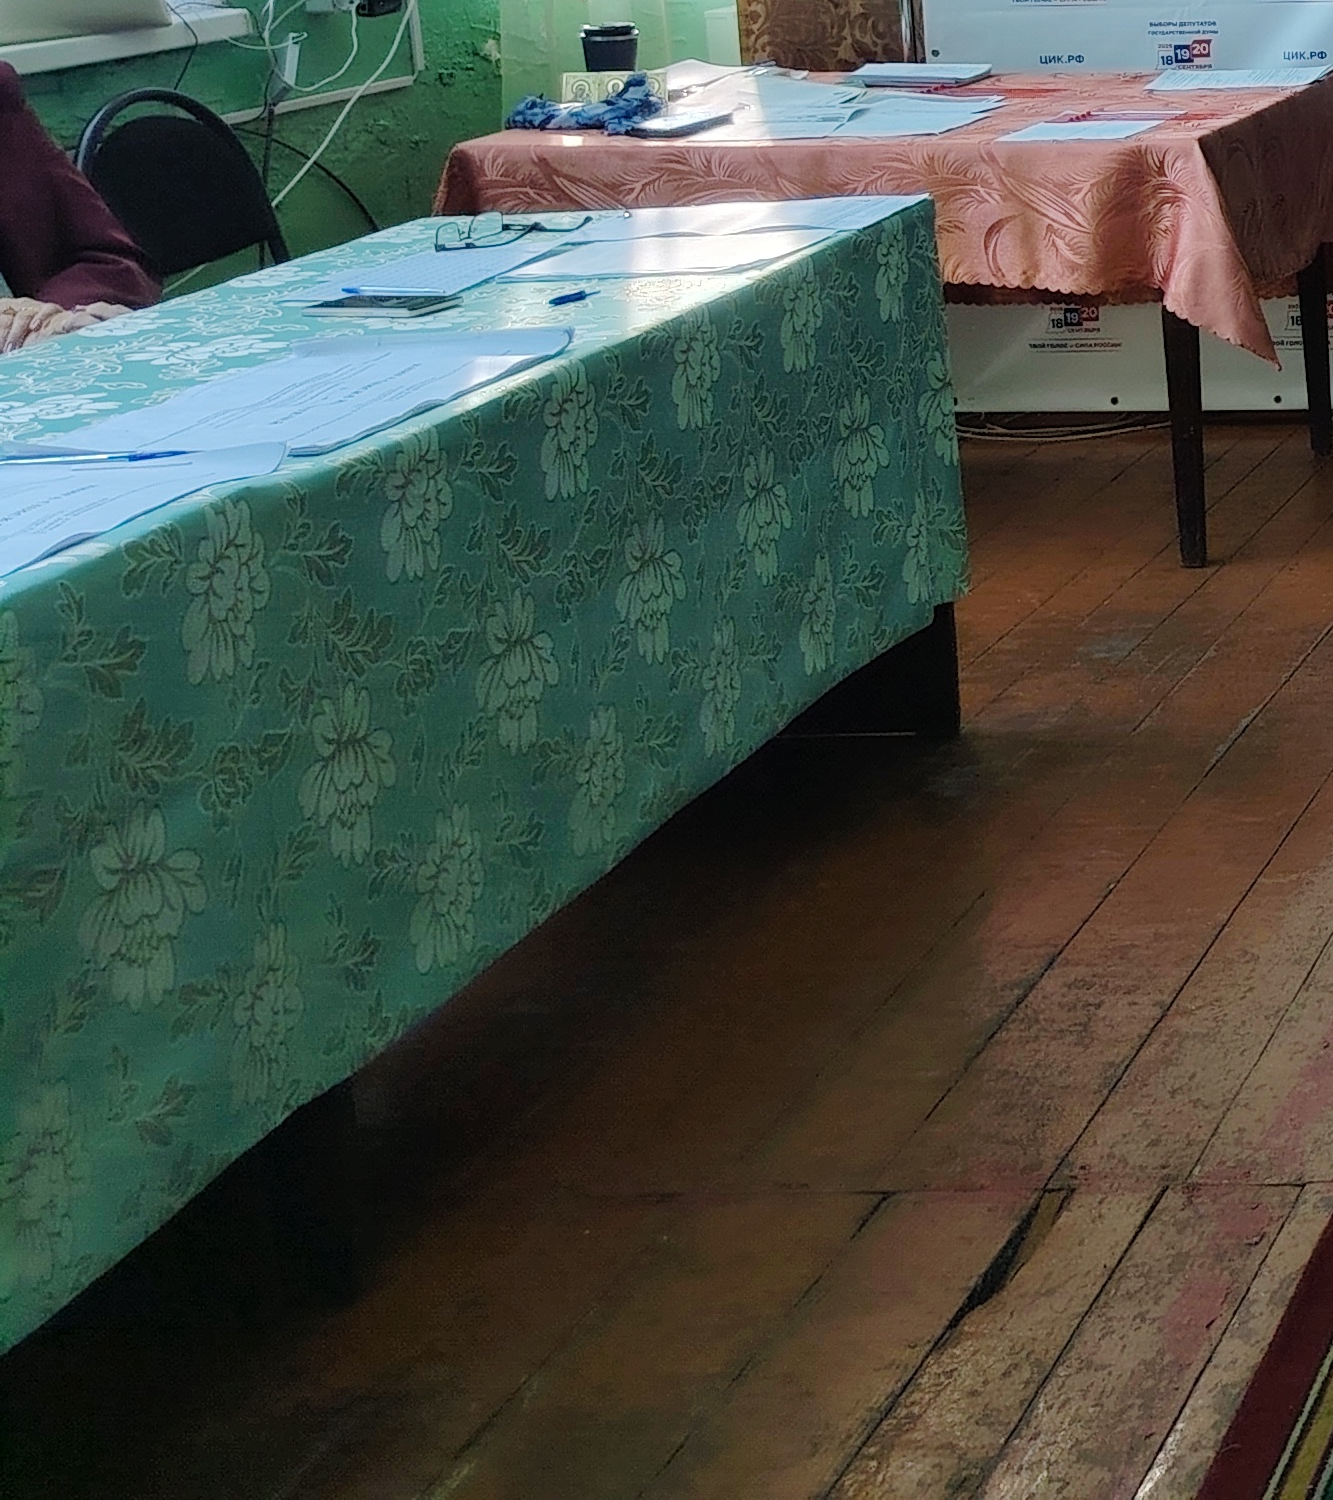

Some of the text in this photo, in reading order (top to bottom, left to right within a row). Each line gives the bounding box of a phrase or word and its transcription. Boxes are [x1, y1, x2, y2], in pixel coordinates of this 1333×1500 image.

[1039, 53, 1085, 66] ЦИК.РФ
[1161, 44, 1208, 65] 18 19 20
[1283, 49, 1328, 62] ЦИК.РФ
[1051, 307, 1098, 328] 18 19 20
